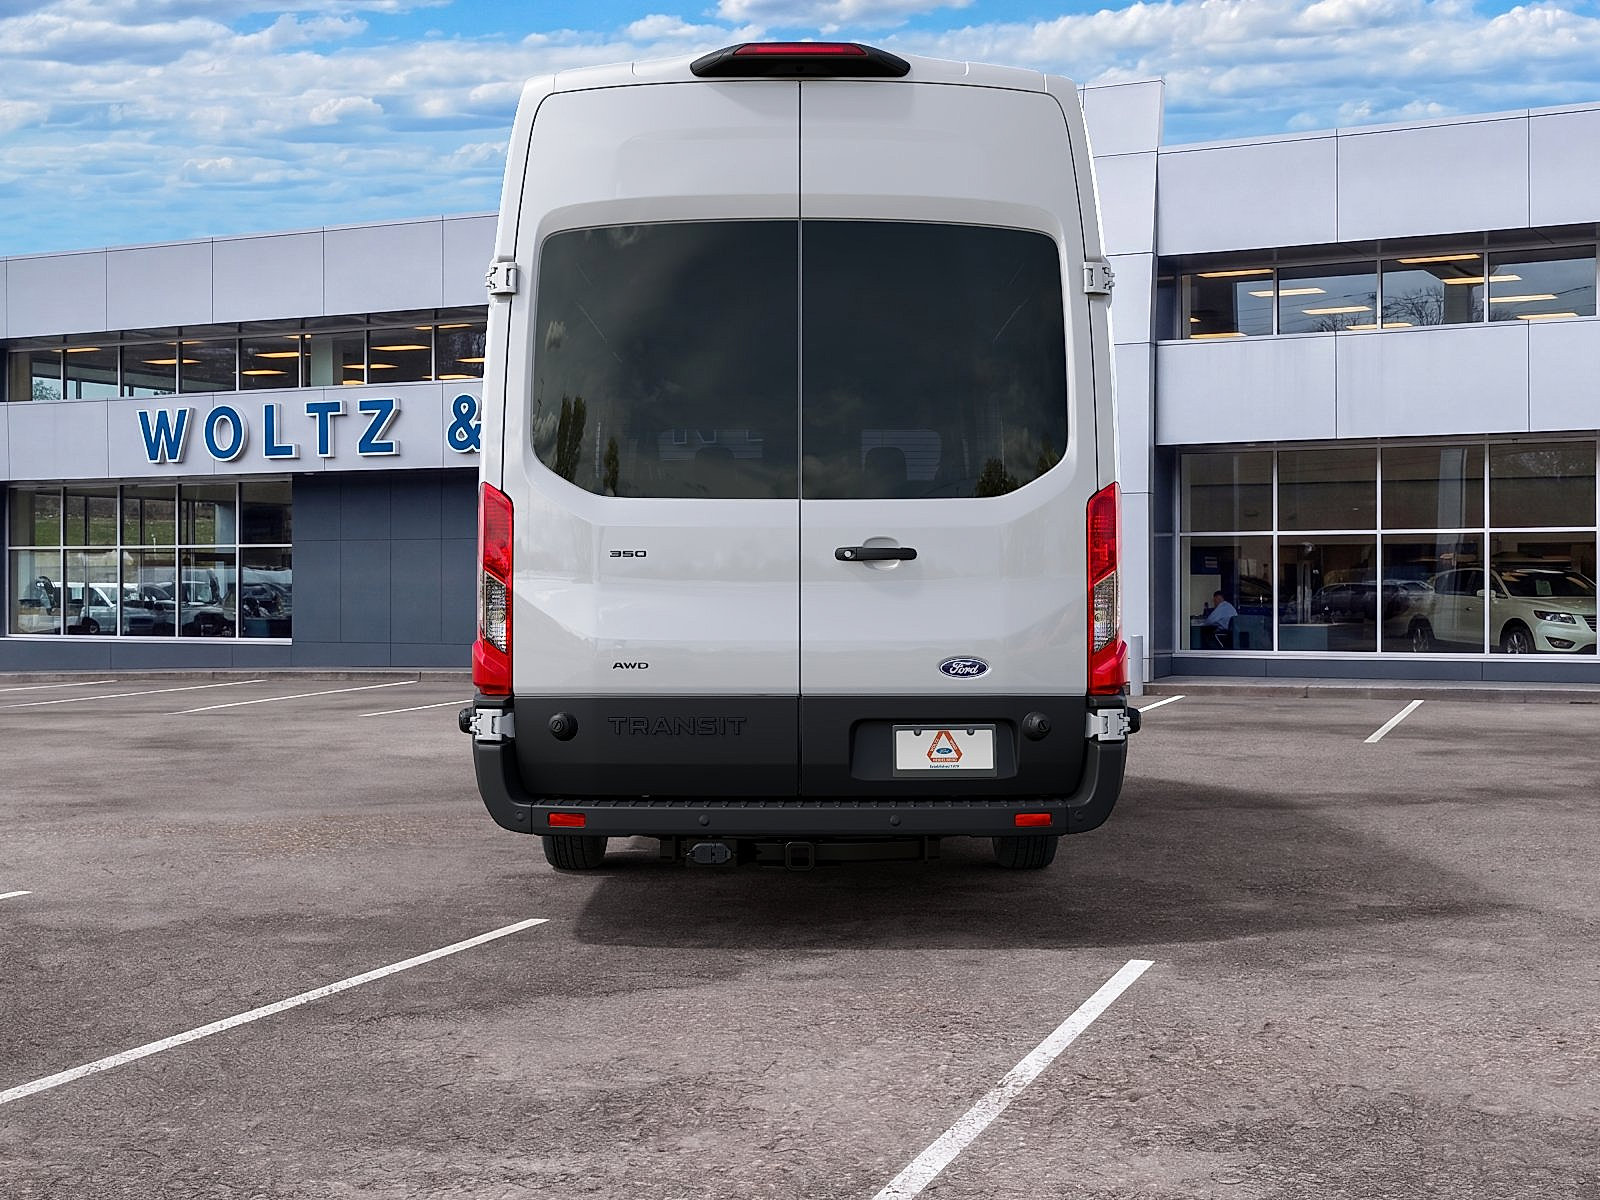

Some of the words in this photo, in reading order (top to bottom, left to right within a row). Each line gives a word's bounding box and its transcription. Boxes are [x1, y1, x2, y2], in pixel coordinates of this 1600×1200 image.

[136, 397, 401, 465] WOLTZ
[446, 392, 481, 453] &
[609, 549, 648, 558] 350
[612, 661, 650, 670] AWD
[949, 661, 980, 675] Ford
[607, 716, 748, 736] TRANSIT
